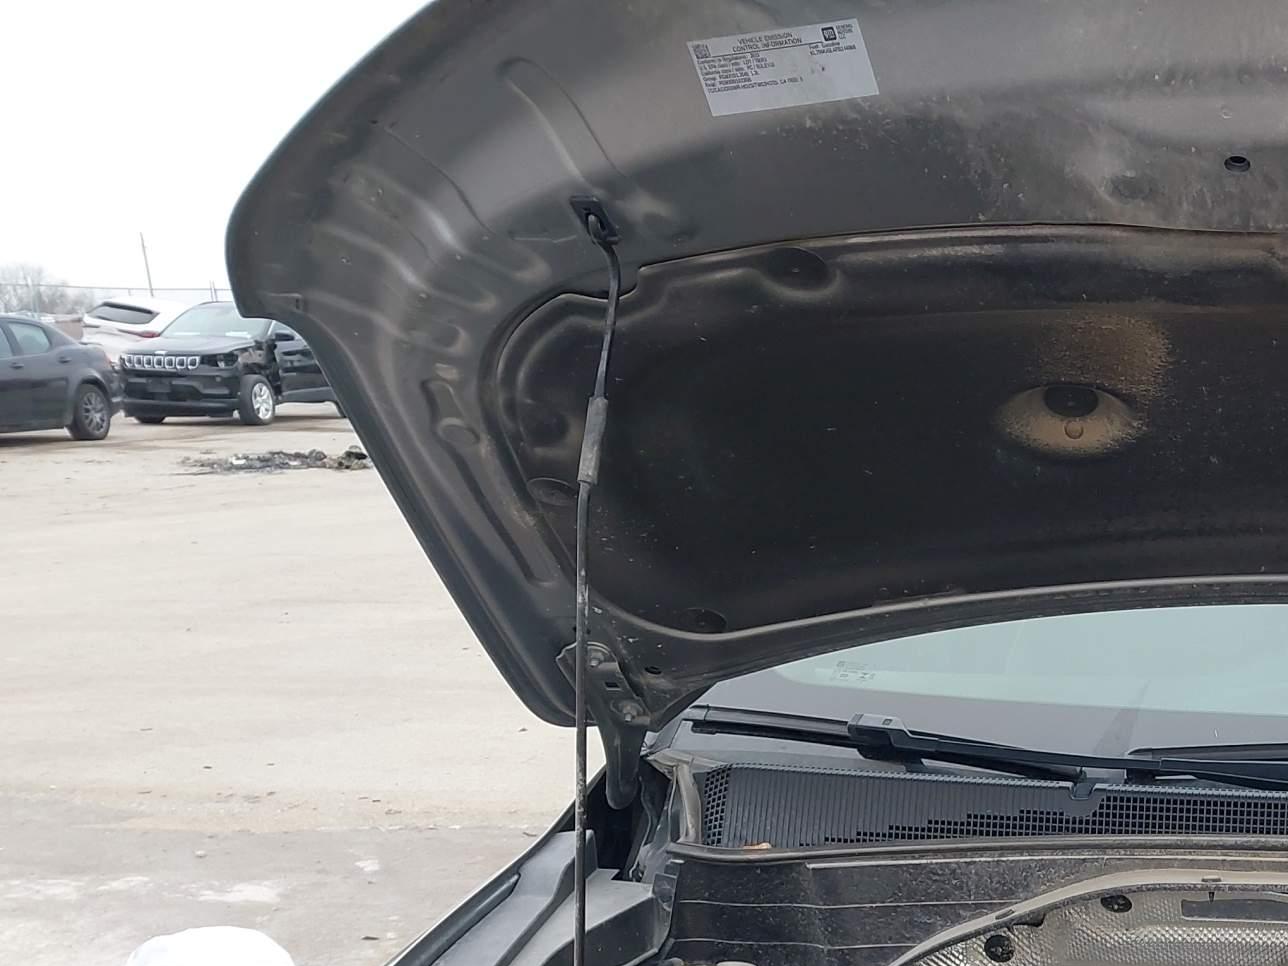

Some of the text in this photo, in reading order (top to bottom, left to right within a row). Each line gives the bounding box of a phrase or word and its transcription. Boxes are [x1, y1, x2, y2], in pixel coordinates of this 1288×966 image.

[732, 41, 761, 53] CONTROL
[761, 37, 802, 50] INFORMATION
[737, 31, 793, 45] VEHICLE EMISSION
